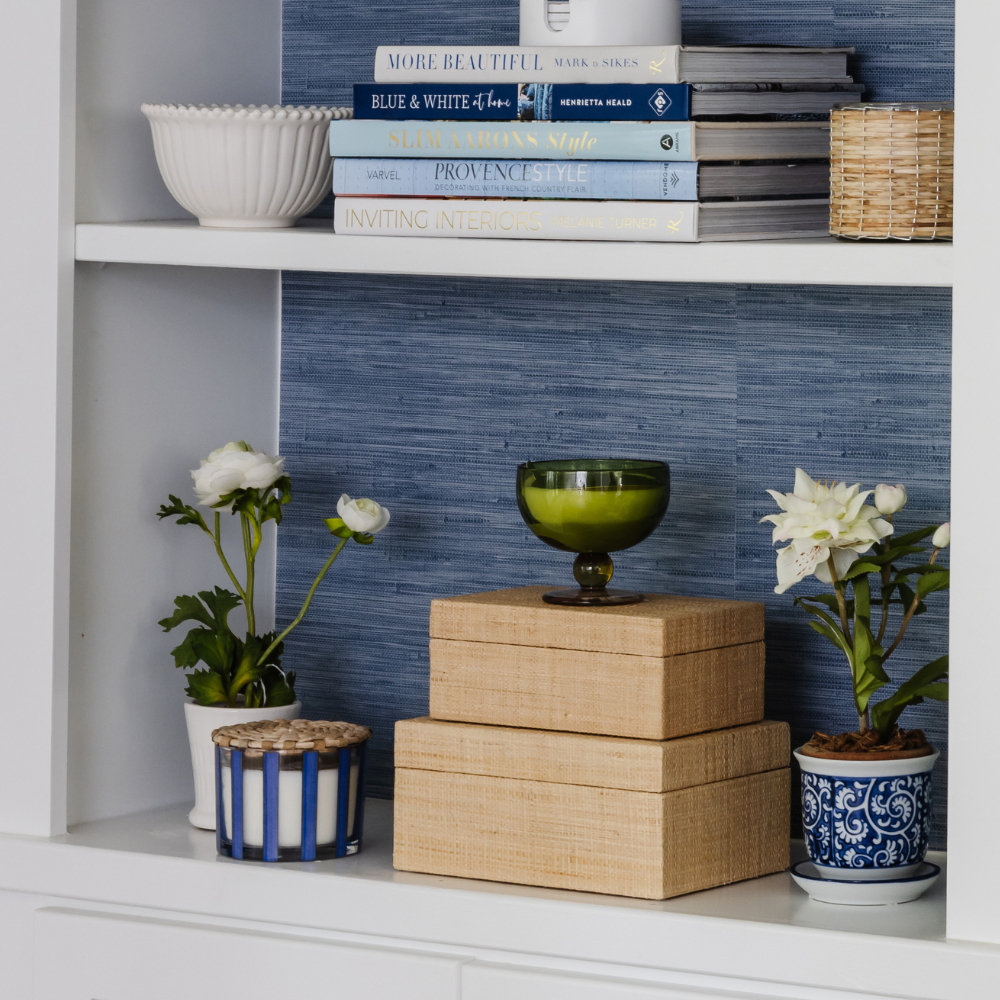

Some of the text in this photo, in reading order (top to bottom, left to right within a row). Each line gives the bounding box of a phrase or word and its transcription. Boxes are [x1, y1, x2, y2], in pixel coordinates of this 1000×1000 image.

[387, 53, 437, 71] MORE
[443, 53, 543, 71] BEAUTIFUL
[554, 58, 589, 68] MARK
[602, 57, 639, 68] SIKES
[371, 89, 512, 111] BLUE & WHITE at home
[560, 98, 632, 107] HENRIETTA HEALD
[388, 129, 598, 156] SLIM AARONS Style
[366, 170, 401, 181] VARVEL
[434, 183, 480, 191] DECORATING
[482, 184, 499, 192] WITH
[531, 185, 565, 193] COUNTRY
[345, 208, 657, 231] INVITING INTERIORS MELANIE TURNER
